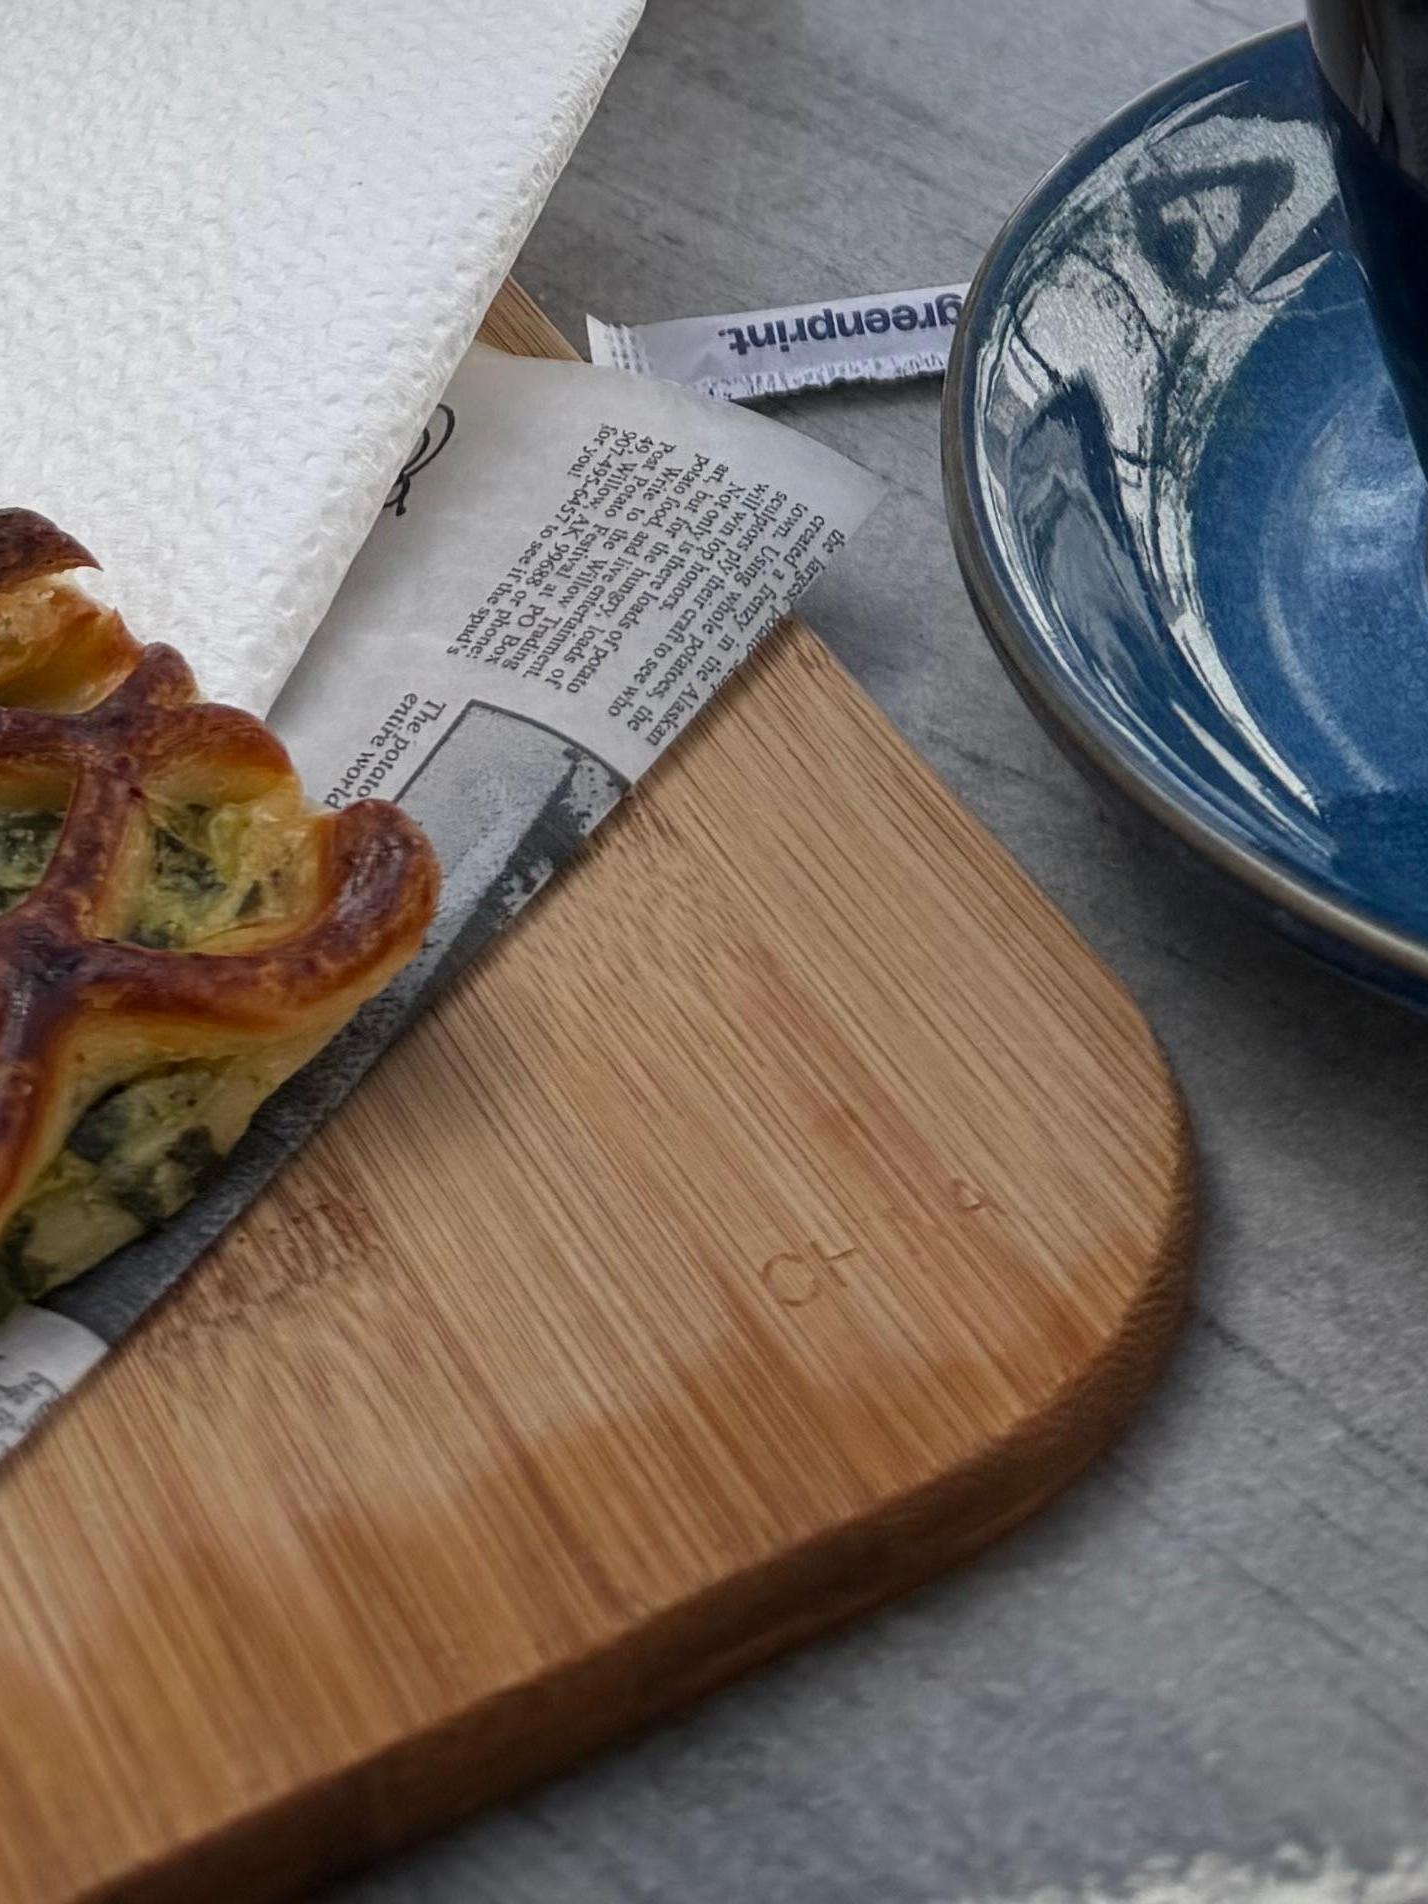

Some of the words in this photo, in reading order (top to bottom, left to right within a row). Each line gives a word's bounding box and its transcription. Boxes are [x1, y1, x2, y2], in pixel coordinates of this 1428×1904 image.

[717, 293, 965, 357] greenprint.
[591, 422, 620, 449] for
[625, 434, 656, 456] 49,
[565, 444, 596, 480] you!
[640, 440, 678, 473] Post
[671, 451, 712, 496] potato
[701, 462, 730, 485] art,
[553, 428, 639, 526] 907-495-6457
[580, 461, 638, 511] Willow,
[641, 466, 685, 503] Write
[603, 473, 651, 520] Potato
[640, 494, 682, 530] food,
[682, 488, 714, 515] but
[712, 480, 748, 511] Not
[738, 482, 771, 513] will
[560, 511, 592, 543] AK
[625, 505, 647, 523] to
[663, 515, 692, 541] for
[685, 508, 721, 543] only
[716, 510, 749, 538] win
[734, 489, 789, 553] sculptors
[770, 501, 810, 540] town.
[538, 523, 561, 541] to
[601, 527, 630, 552] the
[621, 529, 651, 559] and
[676, 539, 696, 557] is
[696, 536, 729, 563] top
[781, 514, 826, 571] created
[821, 527, 846, 555] the
[517, 539, 545, 567] see
[524, 540, 571, 589] 99688
[553, 522, 611, 581] Festival
[642, 540, 671, 565] the
[715, 546, 743, 577] ply
[732, 544, 782, 590] Using
[505, 566, 528, 585] if
[556, 558, 610, 611] Willow
[600, 555, 633, 585] live
[648, 553, 688, 592] there
[656, 559, 712, 612] honors.
[770, 567, 787, 582] a
[780, 554, 828, 609] largest
[485, 581, 515, 607] the
[508, 588, 529, 609] or
[536, 582, 558, 599] at
[593, 566, 653, 620] hungry,
[691, 573, 727, 612] their
[731, 581, 778, 634] frenzy
[515, 602, 548, 630] PO
[616, 589, 661, 631] loads
[663, 606, 698, 645] craft
[700, 590, 744, 637] whole
[464, 607, 514, 661] phone:
[482, 632, 523, 666] Box
[500, 615, 565, 673] Trading
[520, 583, 607, 680] entertainment.
[561, 623, 607, 665] loads
[601, 629, 624, 654] of
[715, 632, 740, 653] in
[644, 632, 707, 700] potatoes,
[651, 640, 675, 660] to
[543, 667, 567, 692] of
[565, 645, 611, 695] potato
[632, 656, 660, 686] see
[694, 654, 723, 684] the
[405, 698, 449, 735] The
[606, 684, 641, 719] who
[625, 703, 655, 733] the
[643, 680, 700, 748] Alaskan
[368, 691, 420, 749] entire
[322, 751, 377, 811] world
[355, 731, 412, 804] potato
